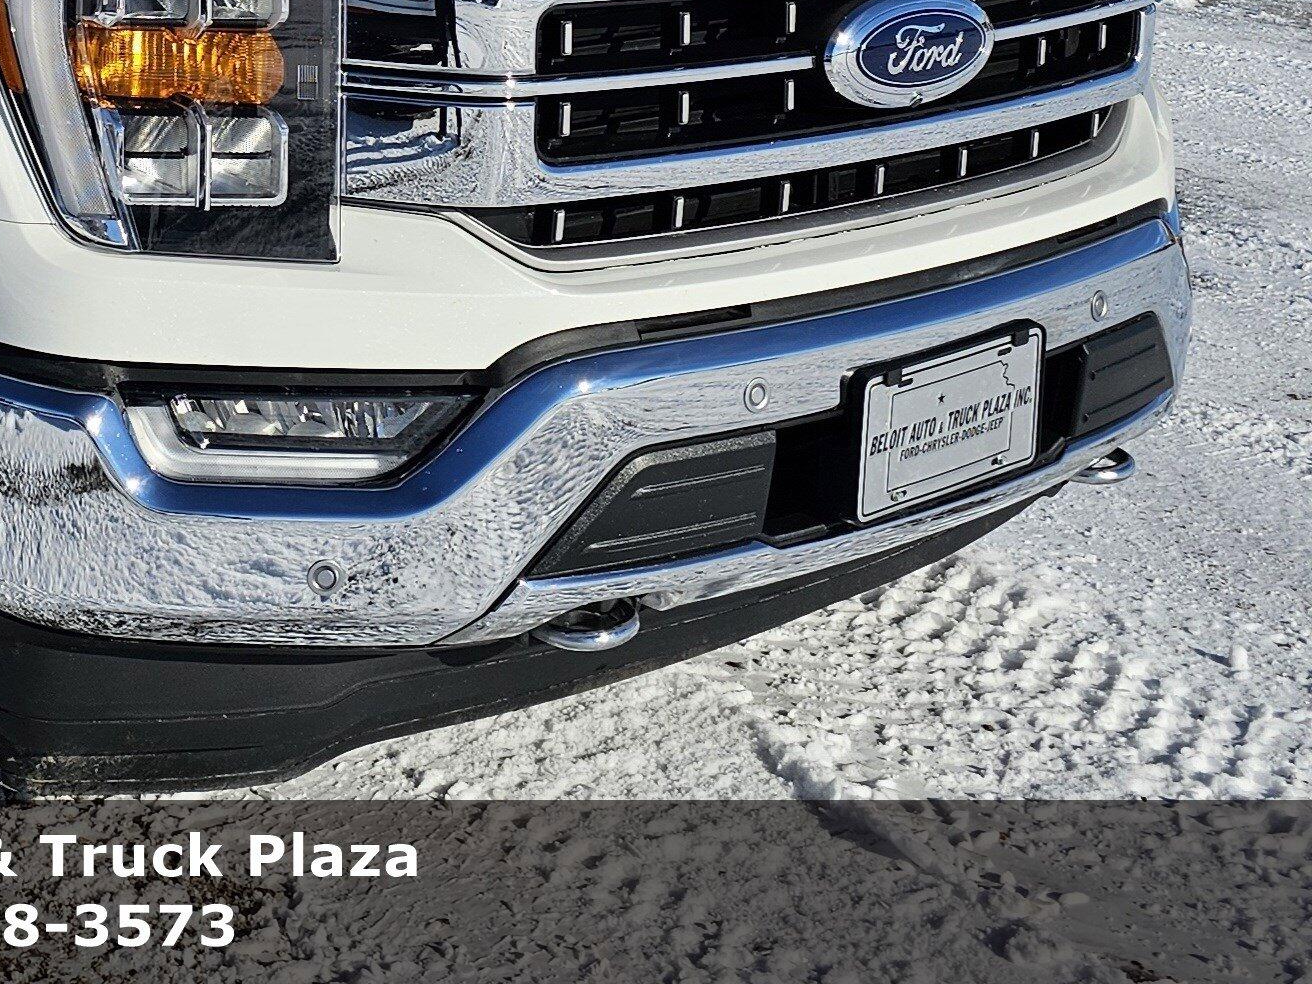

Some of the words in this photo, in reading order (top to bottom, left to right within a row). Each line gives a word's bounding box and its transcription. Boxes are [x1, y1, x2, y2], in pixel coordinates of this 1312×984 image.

[888, 23, 964, 75] Ford
[869, 425, 908, 457] BELOIT
[909, 416, 937, 443] AUTO
[947, 403, 980, 429] TRUCK
[981, 393, 1013, 418] PLAZA
[1014, 385, 1033, 408] INC.
